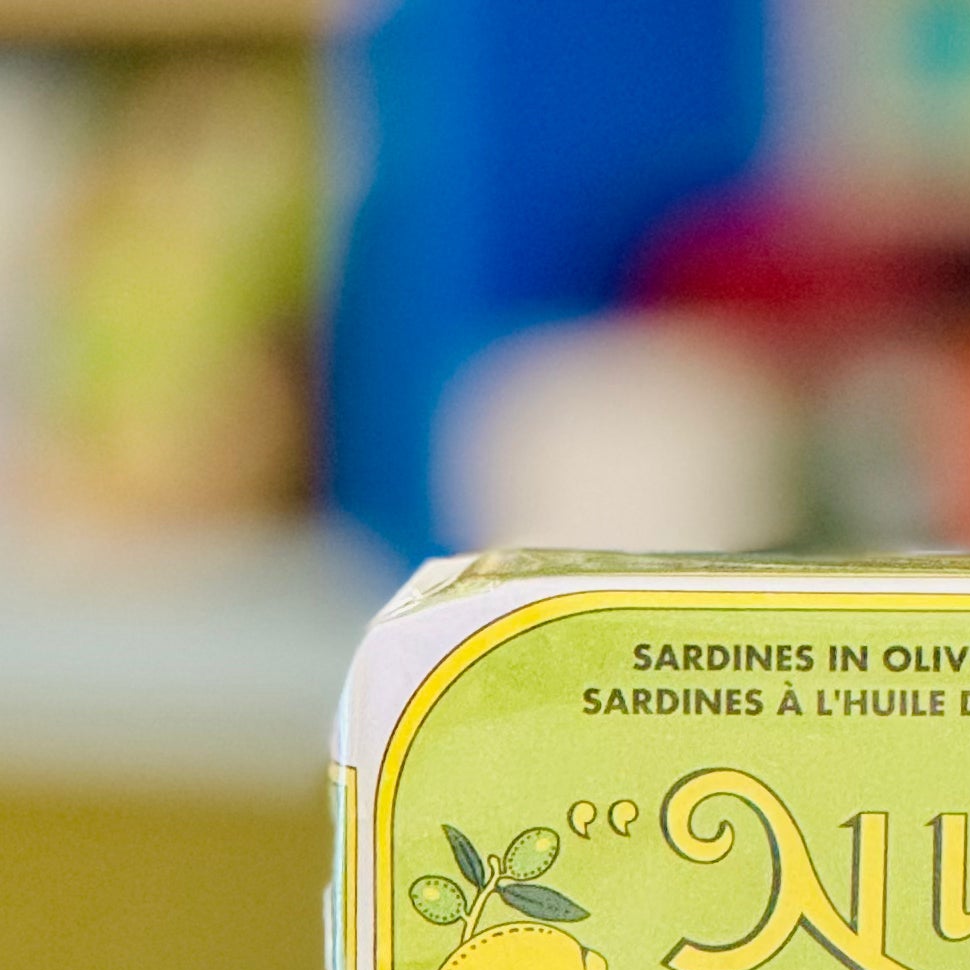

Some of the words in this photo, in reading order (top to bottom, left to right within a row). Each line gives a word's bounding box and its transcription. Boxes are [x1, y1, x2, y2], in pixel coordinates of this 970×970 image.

[633, 643, 814, 673] SARDINES
[829, 645, 868, 673] IN
[582, 687, 762, 716] SARDINES
[776, 681, 803, 716] À
[817, 688, 945, 717] L'HUILE
